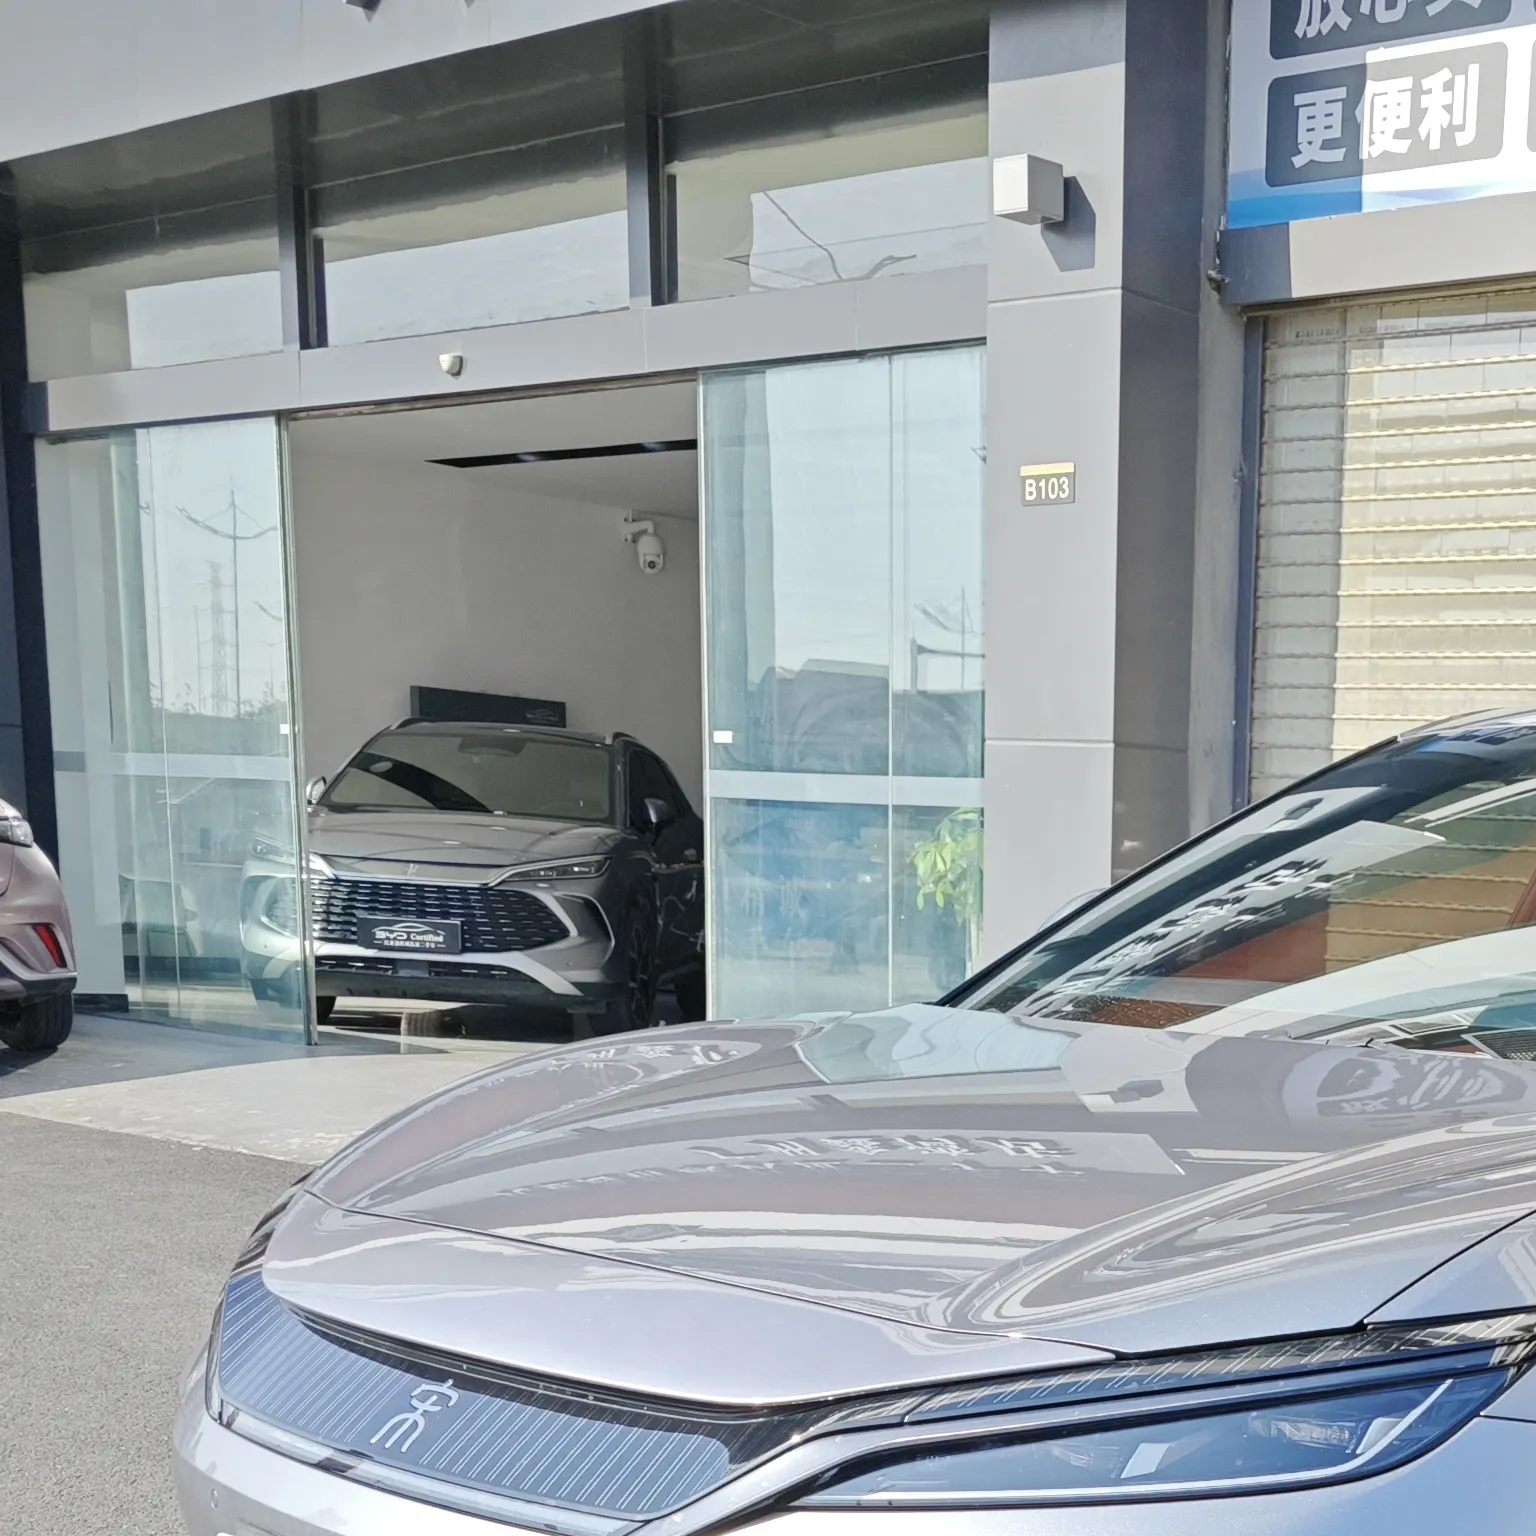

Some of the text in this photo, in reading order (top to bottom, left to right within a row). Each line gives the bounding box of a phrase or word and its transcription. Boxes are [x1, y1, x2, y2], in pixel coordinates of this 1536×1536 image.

[1291, 63, 1479, 168] 更便利
[1025, 477, 1069, 501] B103
[375, 931, 443, 942] BYD Certified
